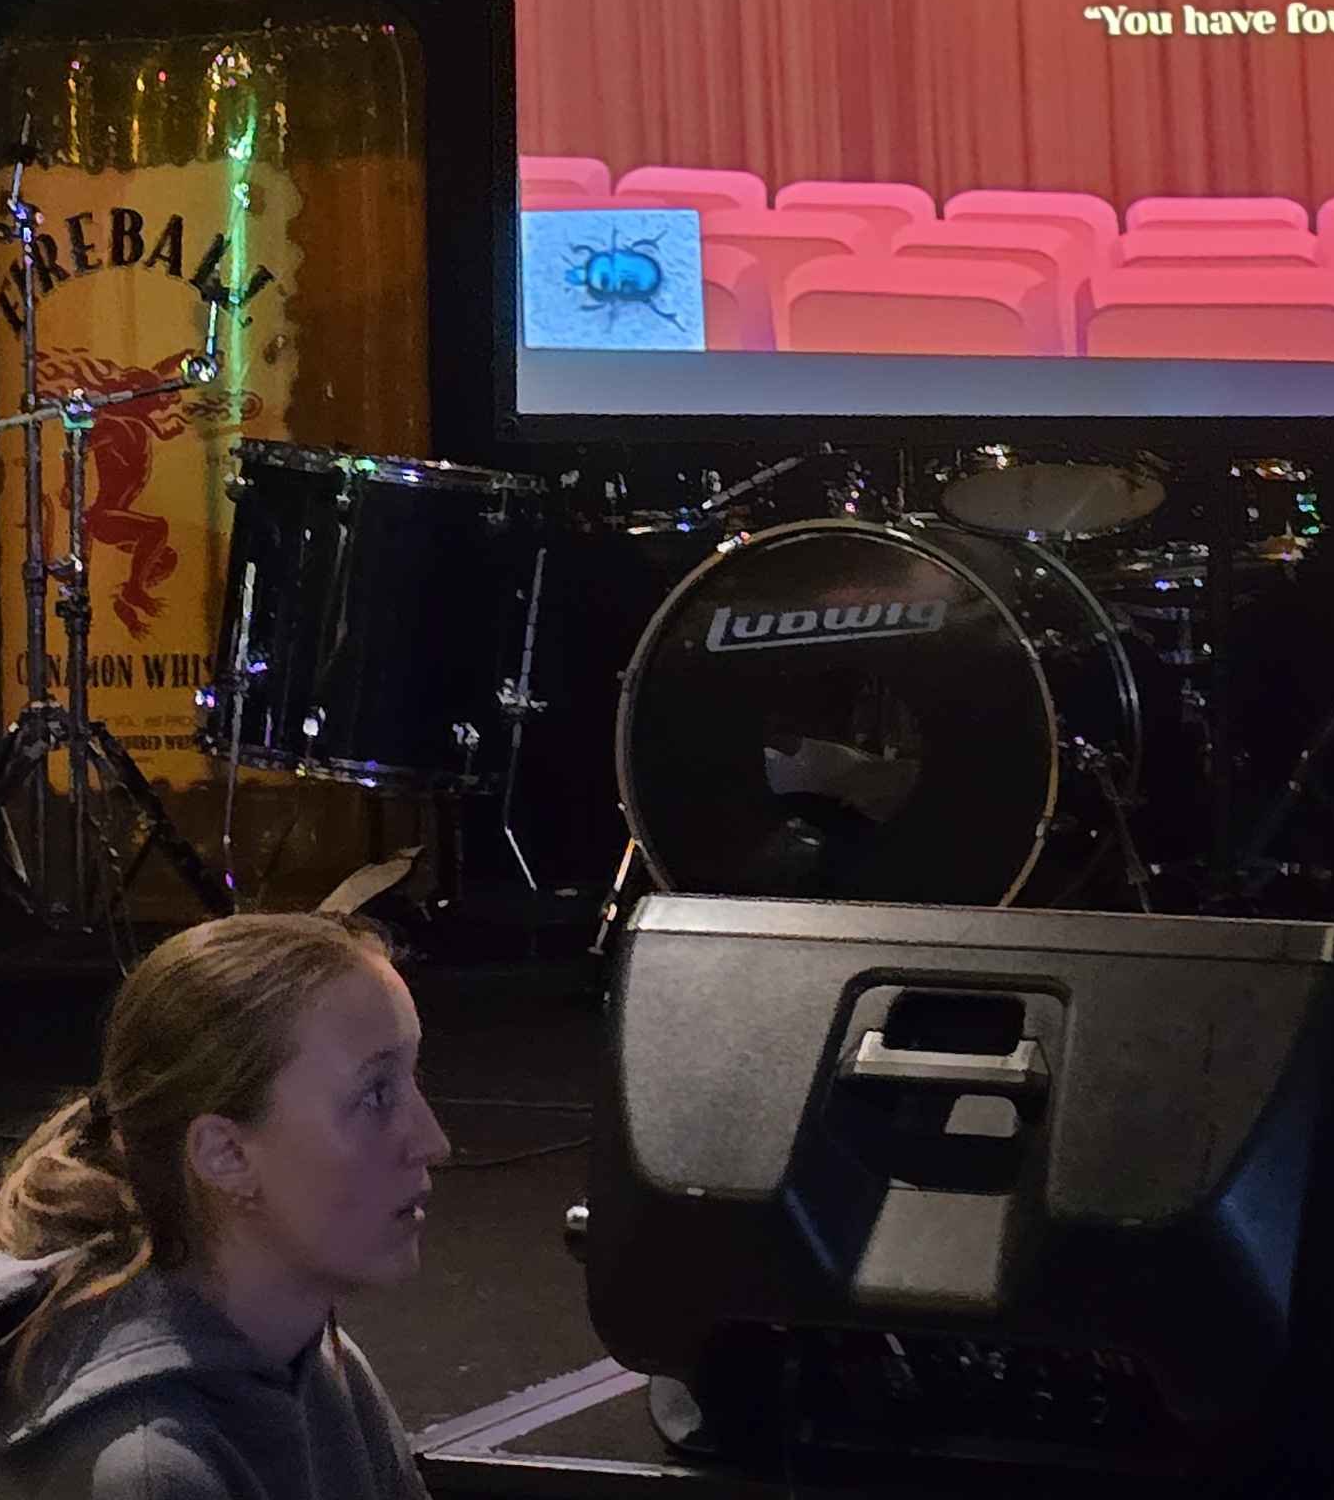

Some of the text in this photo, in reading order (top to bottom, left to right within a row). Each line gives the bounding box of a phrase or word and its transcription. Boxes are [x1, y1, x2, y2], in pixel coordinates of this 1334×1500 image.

[1084, 5, 1173, 36] “You
[1183, 4, 1277, 35] have
[17, 652, 133, 688] CNON
